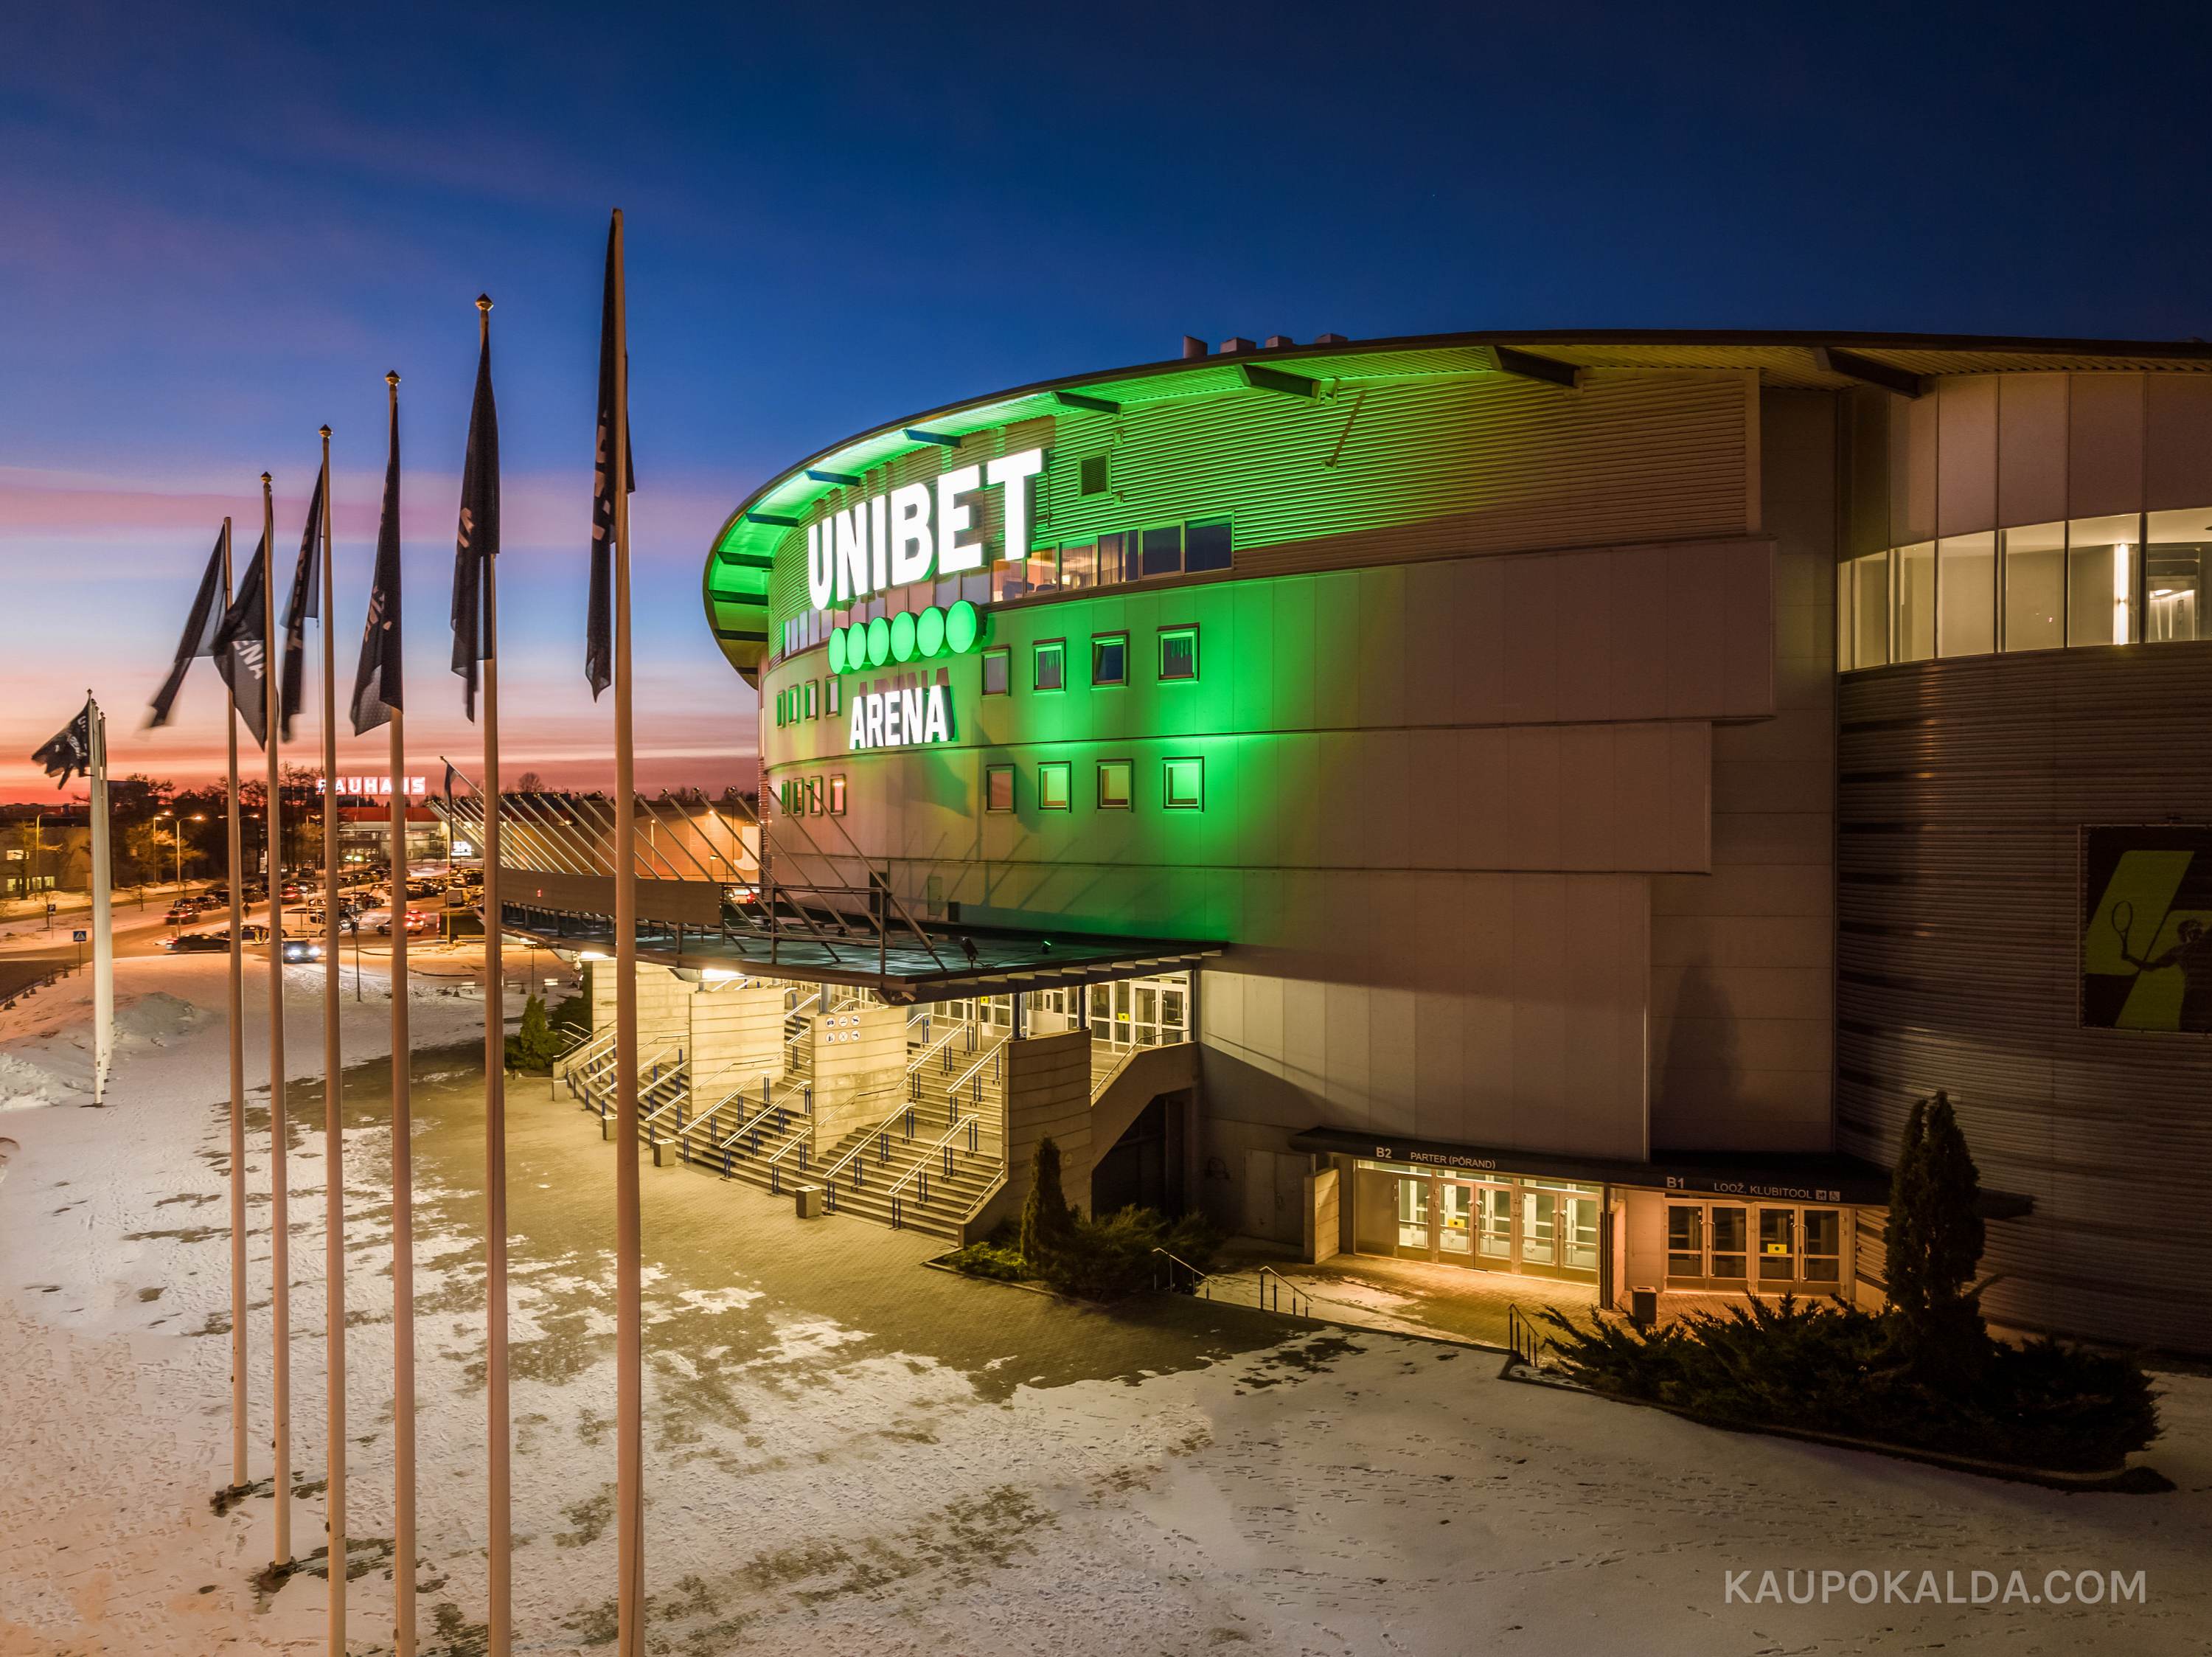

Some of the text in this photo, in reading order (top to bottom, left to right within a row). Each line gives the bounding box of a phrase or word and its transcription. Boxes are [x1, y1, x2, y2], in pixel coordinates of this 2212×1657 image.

[807, 448, 1043, 611] UNIBET
[849, 684, 950, 750] ARENA
[1376, 1147, 1496, 1170] B2 PARTER (PÕRAND)
[1666, 1176, 1685, 1189] B1
[1750, 1185, 1812, 1199] KLUBITOOL
